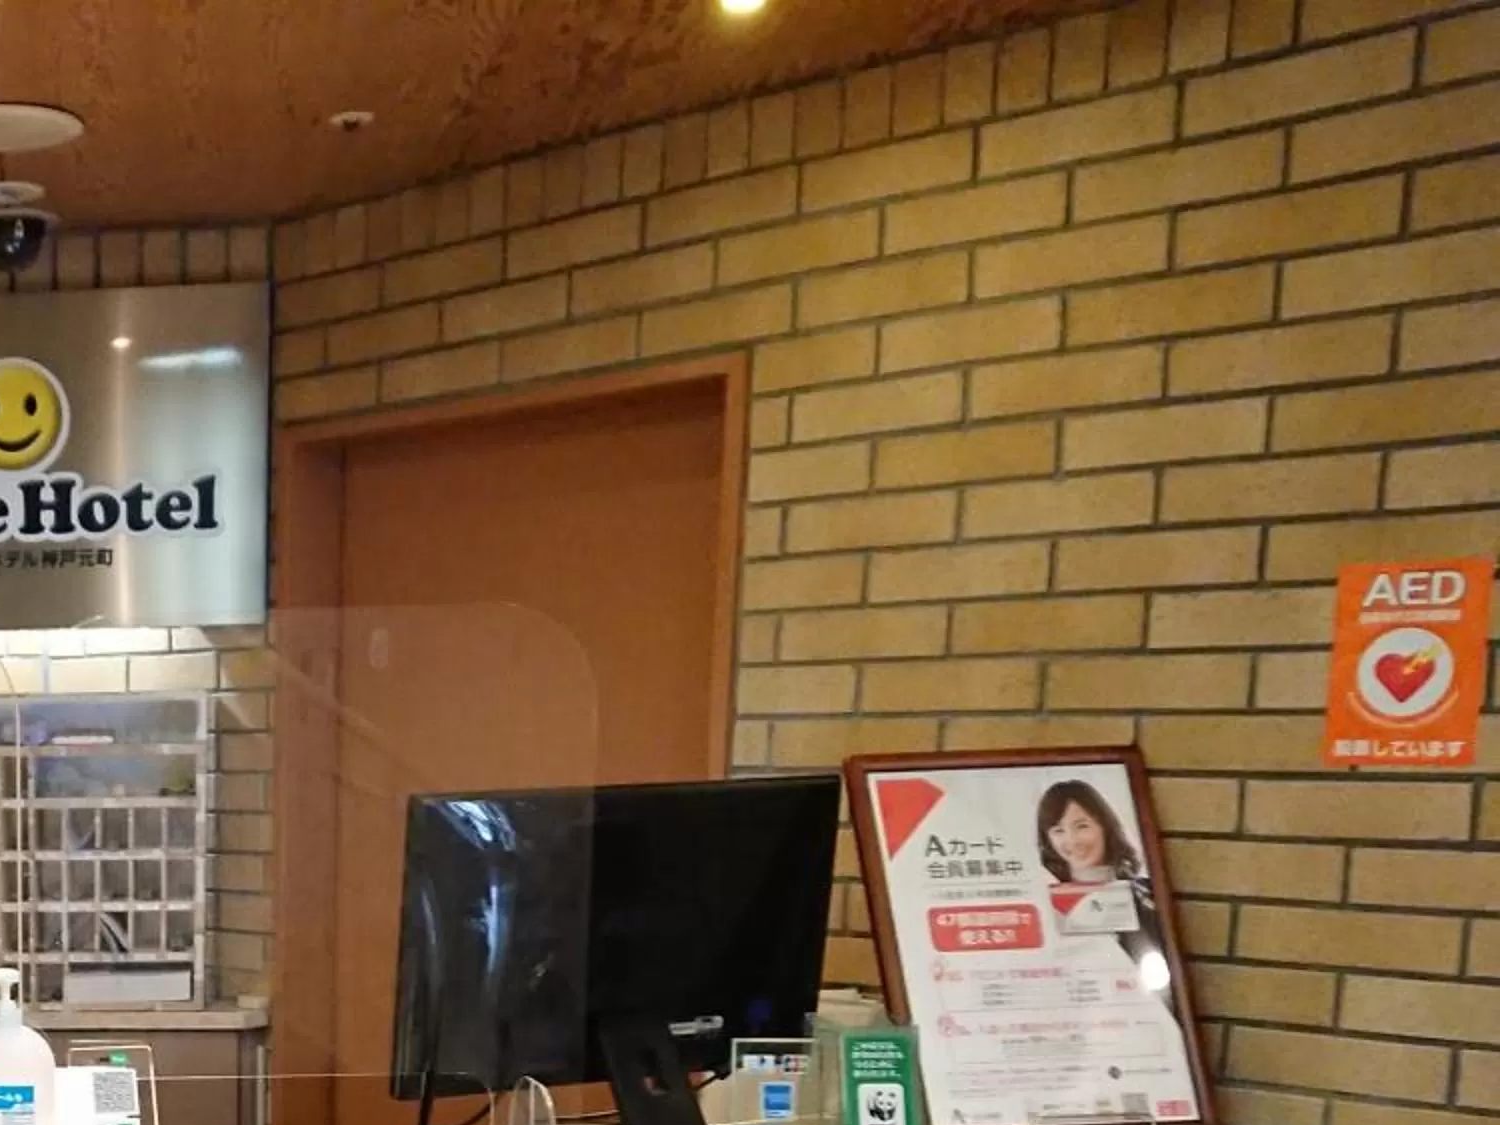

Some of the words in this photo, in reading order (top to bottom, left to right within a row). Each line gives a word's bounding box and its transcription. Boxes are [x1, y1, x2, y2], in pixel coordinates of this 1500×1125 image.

[18, 474, 218, 534] Hotel
[1362, 570, 1466, 607] AED
[925, 834, 1004, 858] Aカード
